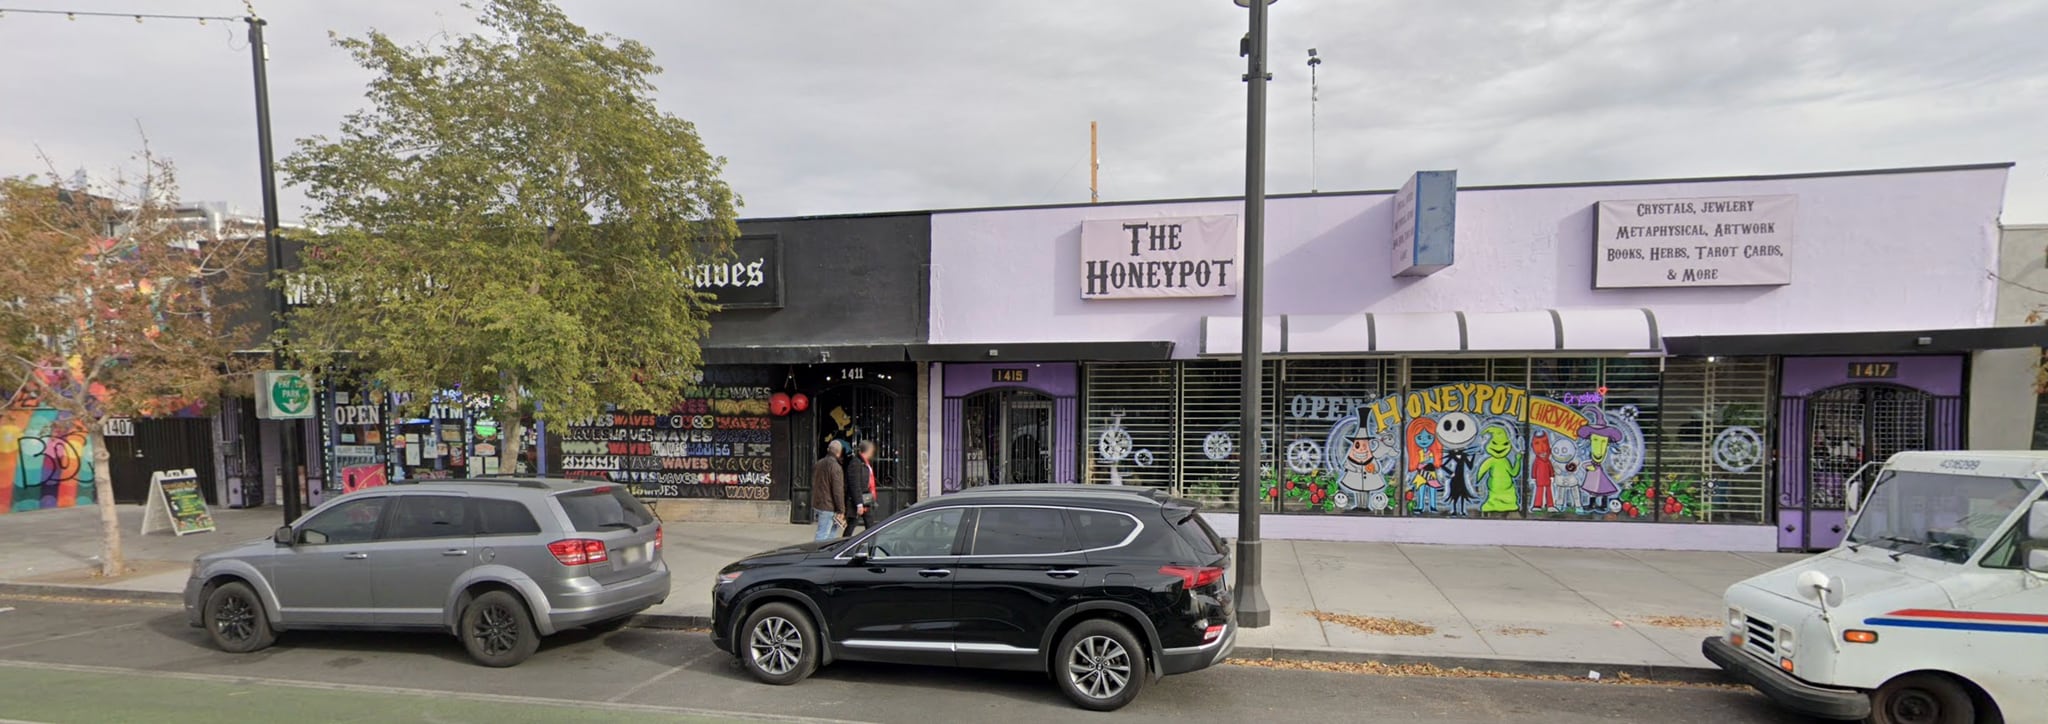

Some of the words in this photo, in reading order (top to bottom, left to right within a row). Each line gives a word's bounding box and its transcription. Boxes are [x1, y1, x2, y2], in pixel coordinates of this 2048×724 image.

[1637, 203, 1696, 216] CRYSTALS,
[1701, 201, 1754, 213] JEWLERY
[1616, 225, 1708, 239] METAPHYSICAL,
[1714, 223, 1775, 237] ARTWORK
[1123, 222, 1182, 256] THE
[1607, 248, 1645, 261] BOOKS,
[1650, 247, 1690, 260] HERBS,
[1695, 246, 1739, 259] TAROT
[1744, 245, 1784, 258] CARDS,
[1085, 258, 1233, 295] HONEYPOT
[1667, 269, 1676, 280] &
[1682, 269, 1718, 282] MORE
[841, 368, 864, 379] 1411
[996, 370, 1023, 381] 1415
[1855, 364, 1890, 376] 1417
[730, 387, 772, 398] WAVES
[335, 405, 380, 425] OPEN
[428, 404, 463, 419] ATM
[1371, 382, 1526, 433] HONEYPOT
[106, 420, 134, 435] 1407
[662, 458, 709, 470] WAVES
[725, 486, 770, 499] WAVES
